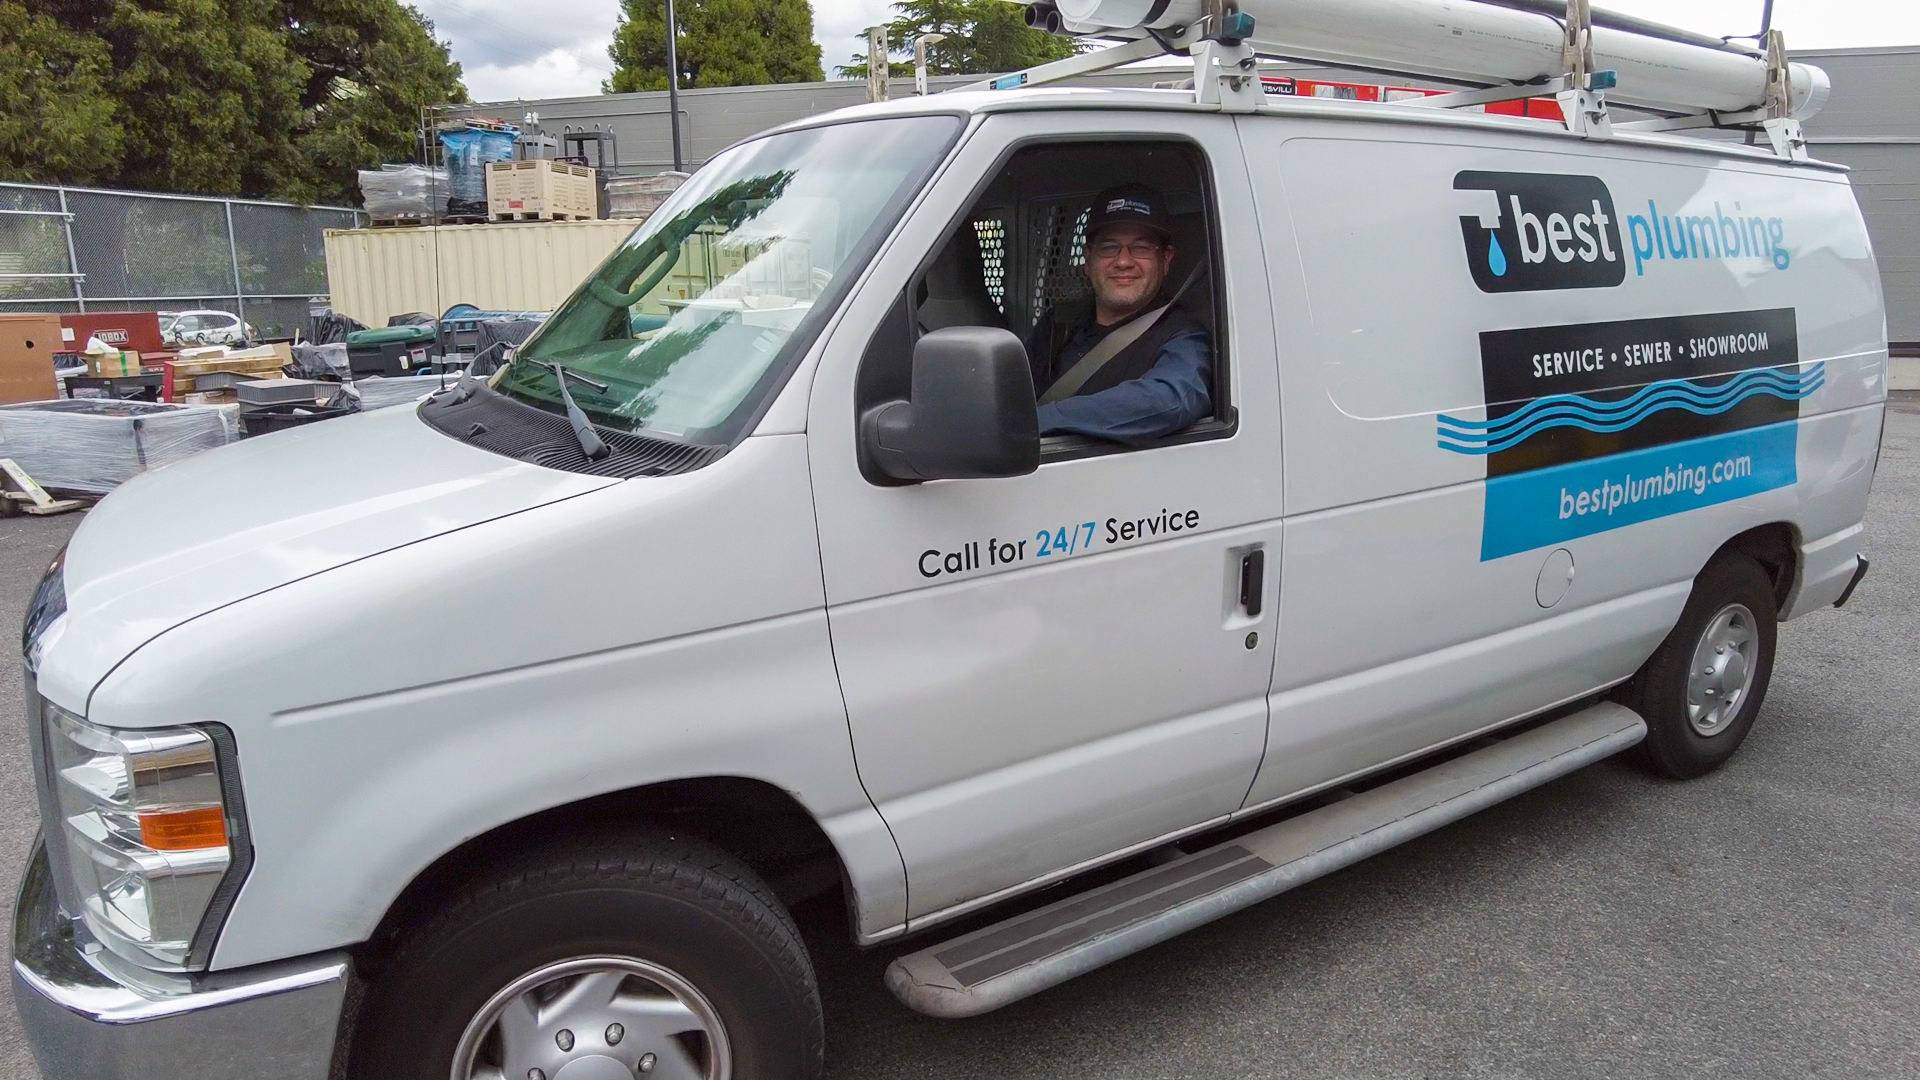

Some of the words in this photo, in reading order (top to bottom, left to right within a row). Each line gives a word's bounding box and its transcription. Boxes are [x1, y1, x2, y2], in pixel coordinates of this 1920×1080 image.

[1510, 195, 1616, 264] best
[1627, 199, 1790, 276] plumbing
[1532, 348, 1604, 378] SERVICE
[1623, 341, 1672, 367] SEWER
[1689, 332, 1769, 359] SHOWROOM
[1559, 455, 1751, 520] bestplumbing.com
[918, 541, 980, 578] Call
[988, 538, 1027, 566] for
[1035, 522, 1096, 557] 24/7
[1105, 508, 1200, 544] Service
